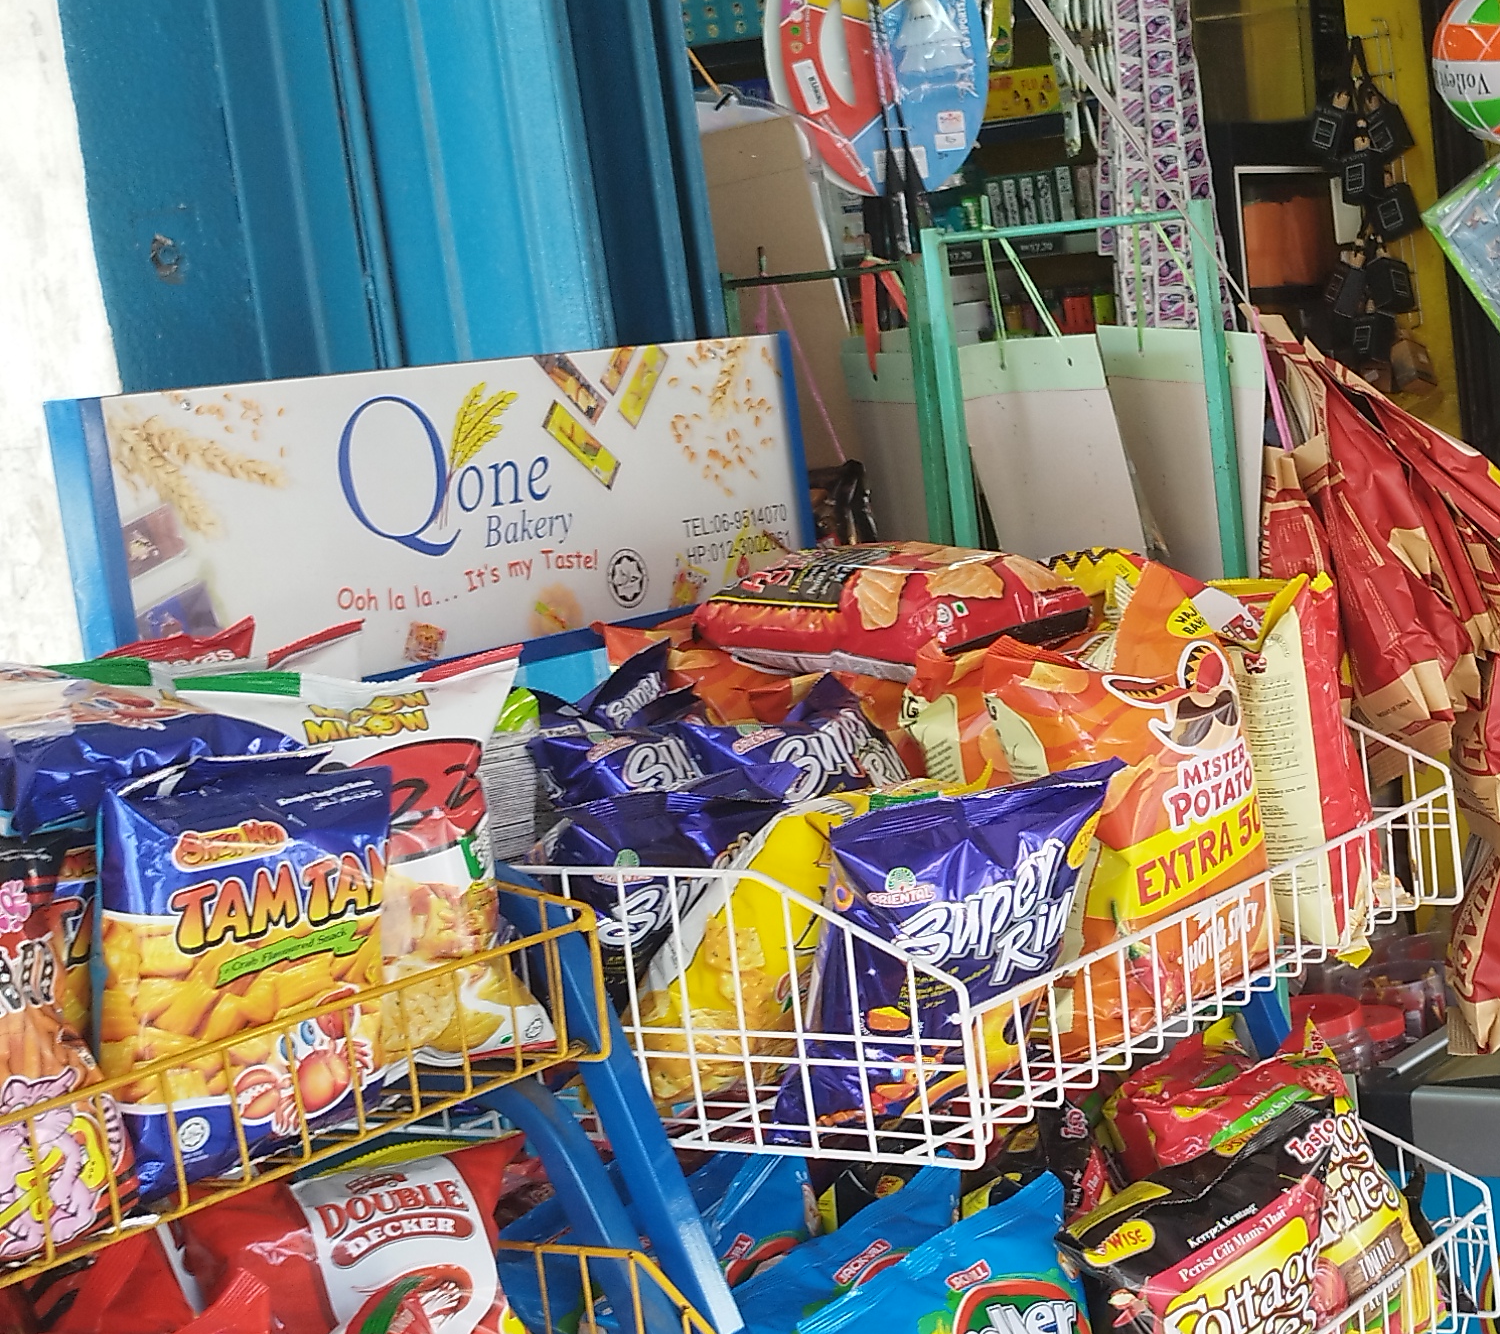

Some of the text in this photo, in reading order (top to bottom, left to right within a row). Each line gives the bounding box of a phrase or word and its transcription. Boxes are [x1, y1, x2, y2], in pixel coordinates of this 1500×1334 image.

[484, 509, 573, 549] Bakery
[464, 548, 598, 593] It's my Taste!
[338, 585, 378, 611] Ooh
[388, 586, 406, 610] la
[302, 708, 431, 746] MIAOW
[1182, 742, 1247, 789] MISTER
[1168, 763, 1254, 828] POTATO
[1137, 828, 1232, 907] EXTRA
[172, 865, 304, 956] TAM
[867, 884, 937, 907] ORIENTAL
[896, 838, 1067, 968] Super
[1288, 1117, 1337, 1163] Tasto
[314, 1177, 471, 1240] DOUBLE
[344, 1217, 457, 1259] DECKER
[1107, 1230, 1147, 1255] WISE
